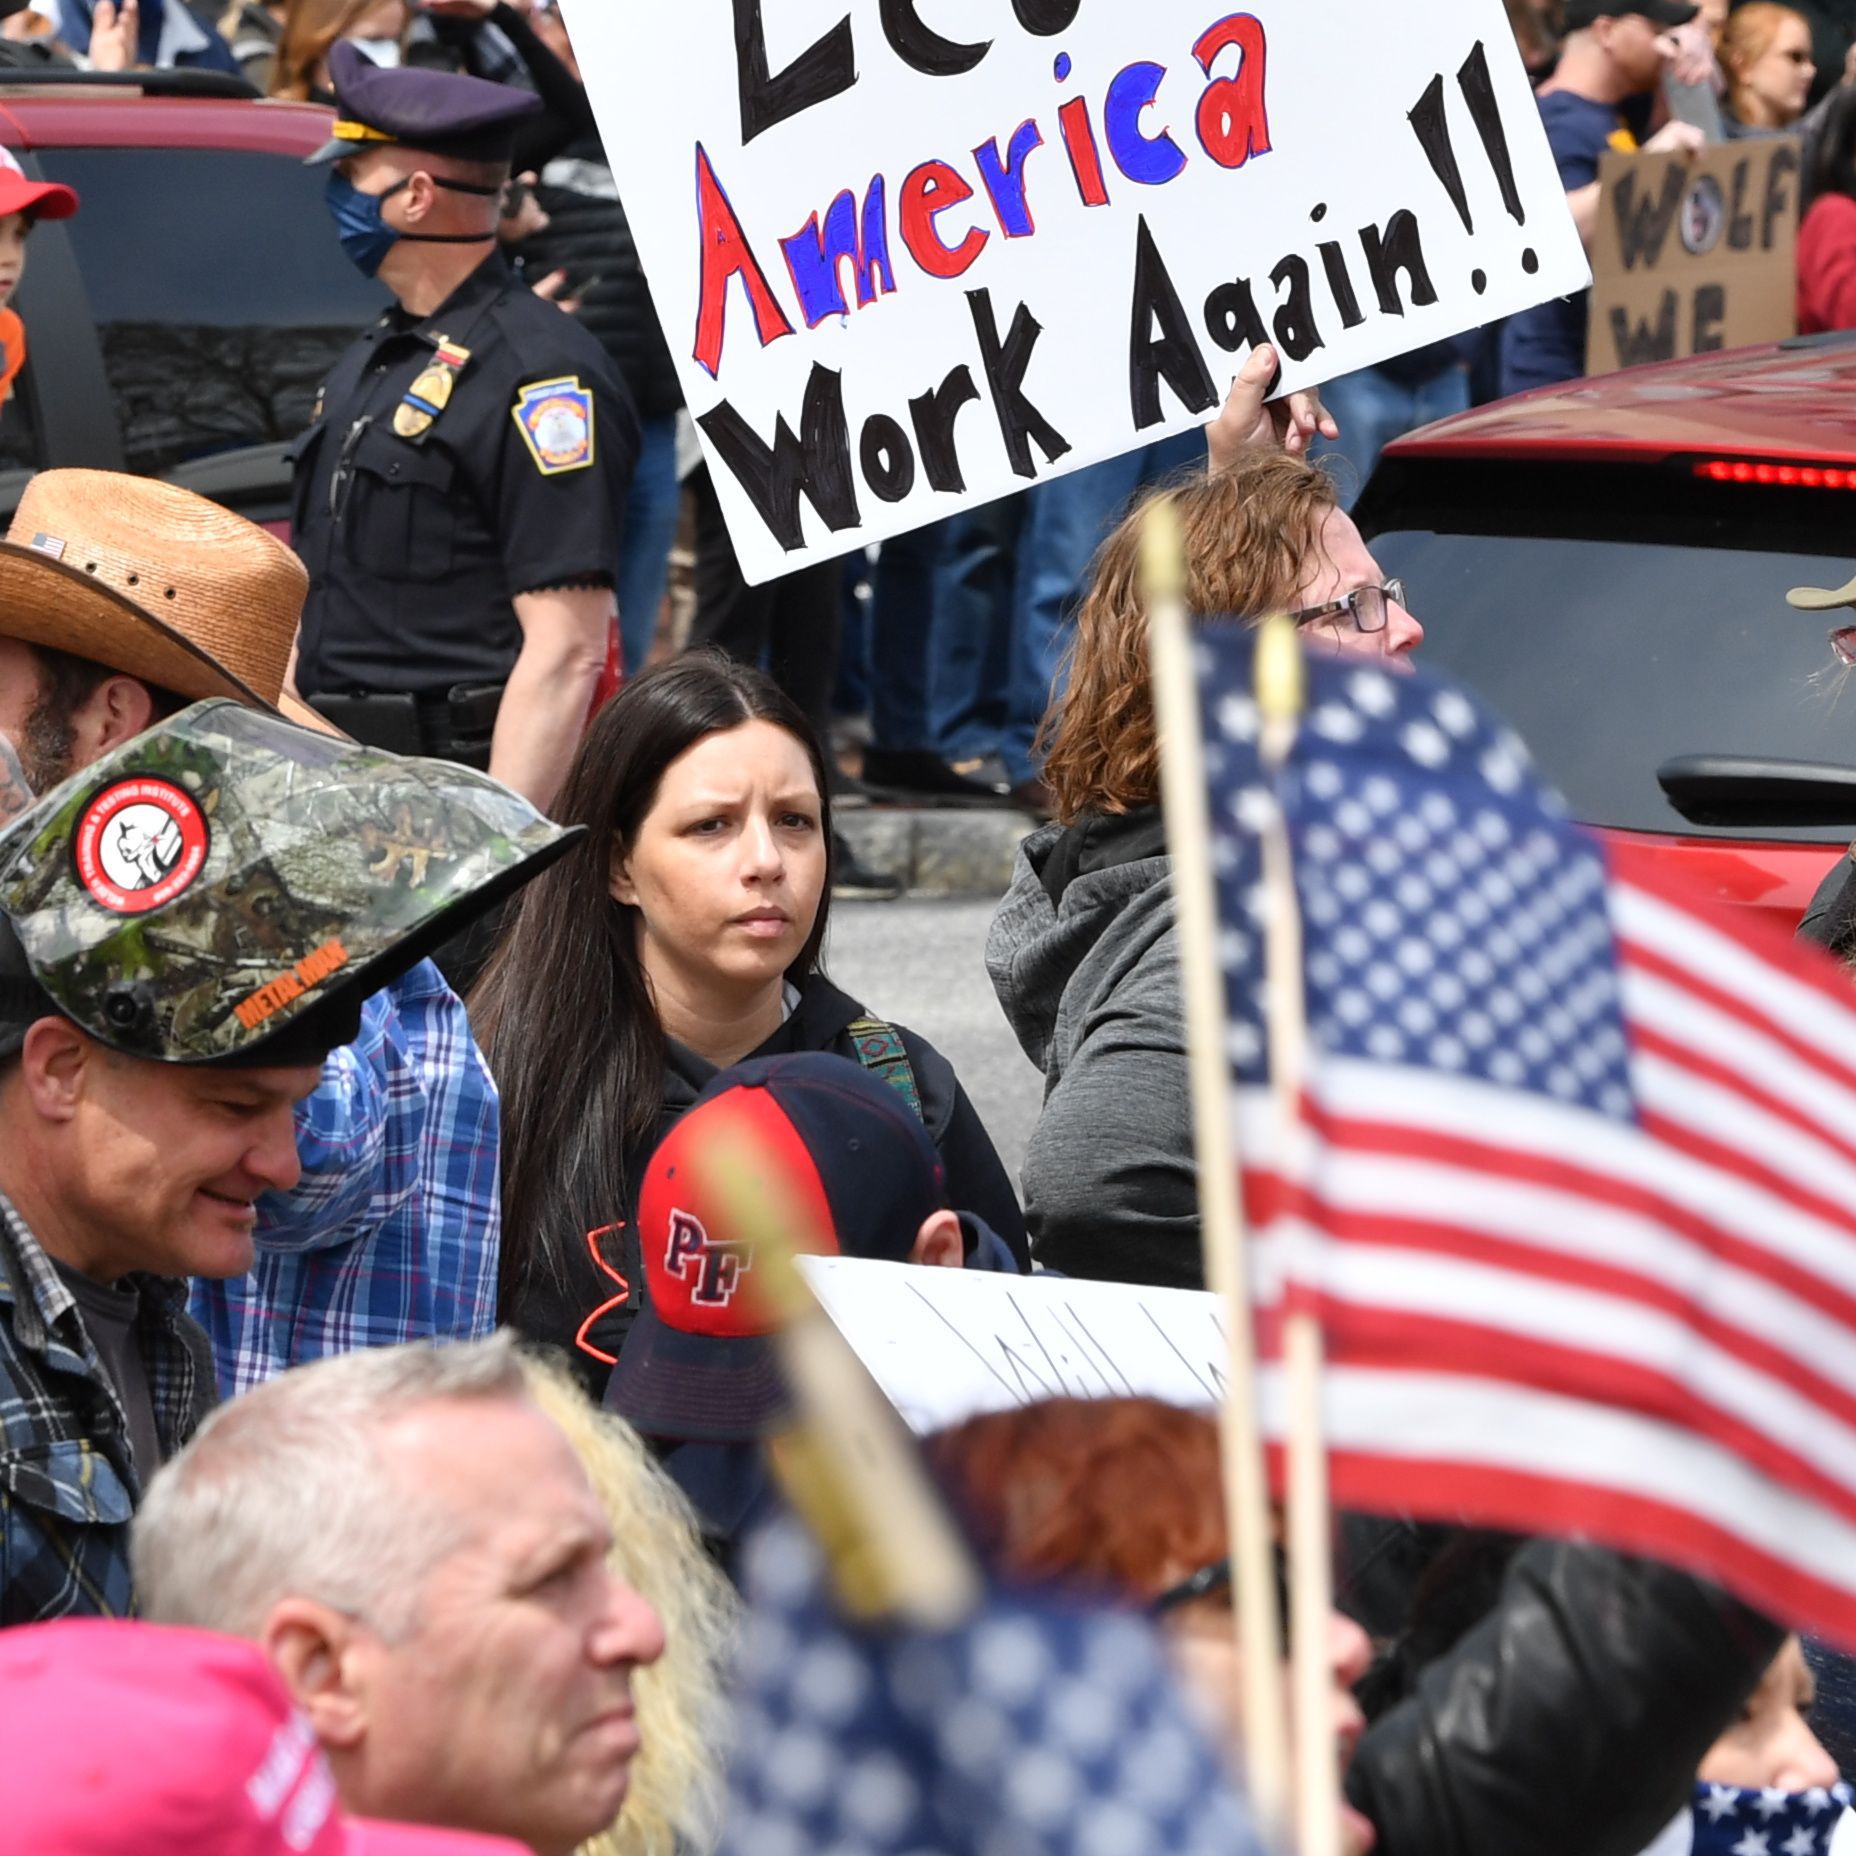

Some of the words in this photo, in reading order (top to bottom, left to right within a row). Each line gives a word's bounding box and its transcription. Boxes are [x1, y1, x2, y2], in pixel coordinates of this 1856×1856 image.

[693, 12, 1272, 380] America
[695, 286, 1070, 552] Work
[1127, 40, 1539, 434] Again!!
[233, 969, 307, 1031] METAL
[293, 935, 351, 990] MAN
